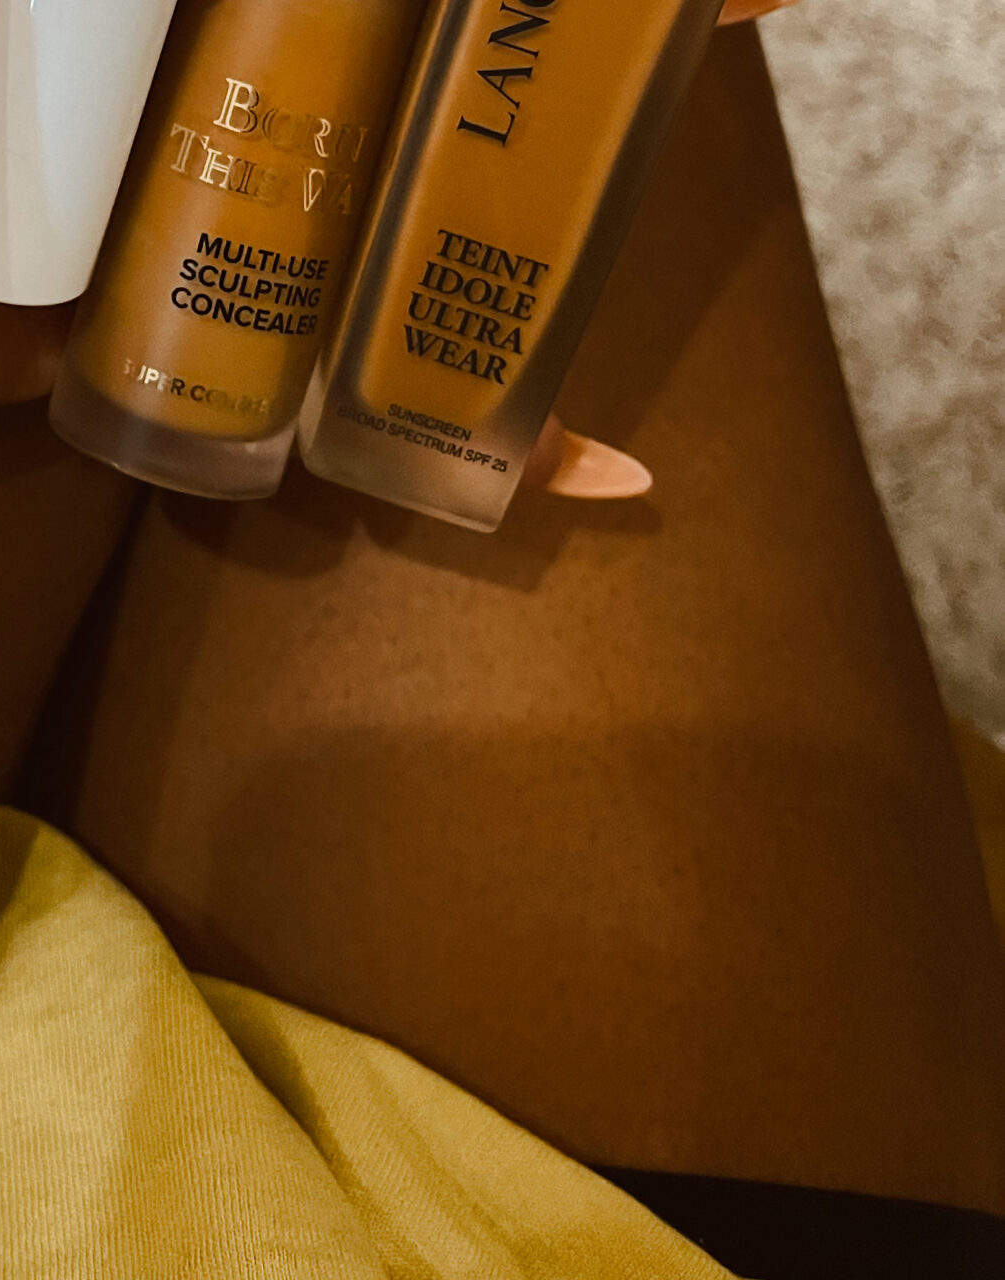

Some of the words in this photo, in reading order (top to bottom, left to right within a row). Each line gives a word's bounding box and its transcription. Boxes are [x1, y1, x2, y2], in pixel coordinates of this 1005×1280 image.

[179, 258, 321, 308] SCULPTING
[196, 232, 330, 280] MULTI-USE
[436, 229, 549, 289] TEINT
[171, 286, 318, 335] CONCEALER
[418, 261, 536, 321] IDOLE
[408, 291, 523, 355] ULTRA
[403, 324, 509, 385] WEAR
[337, 404, 387, 432] BROAD
[387, 422, 463, 458] SPECTRUM
[464, 449, 492, 466] SPF
[387, 403, 472, 442] SUNSCREEN
